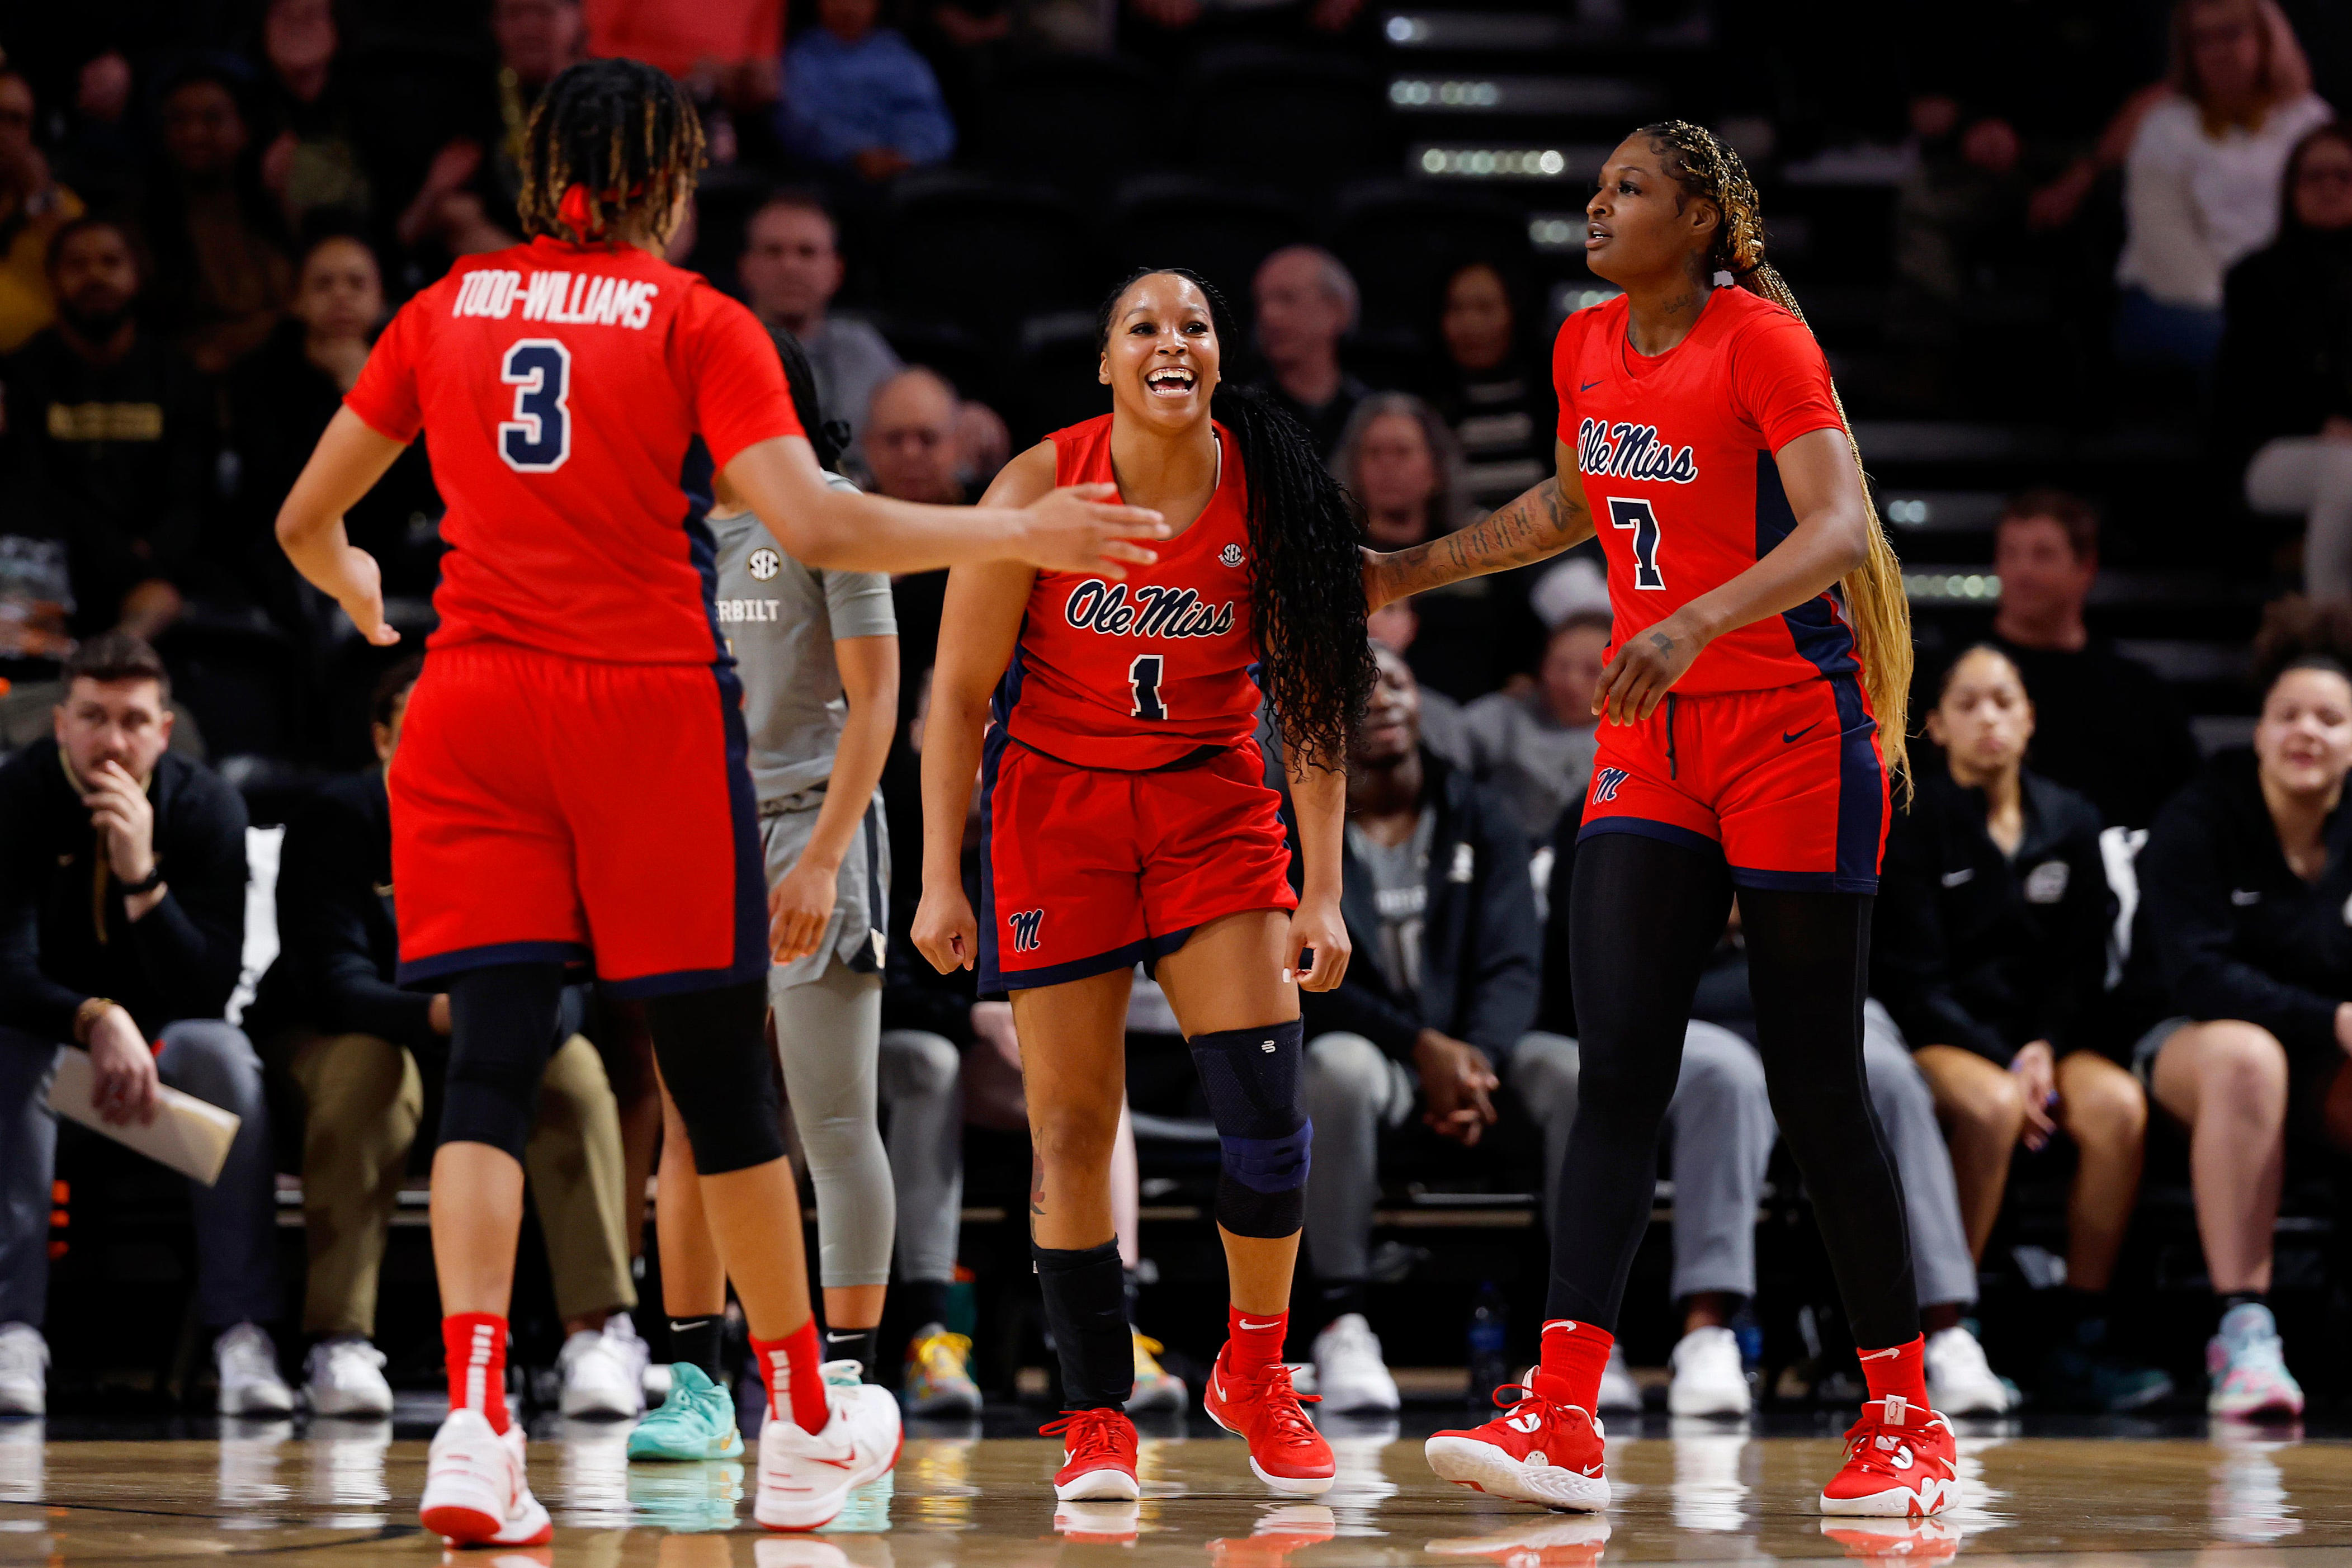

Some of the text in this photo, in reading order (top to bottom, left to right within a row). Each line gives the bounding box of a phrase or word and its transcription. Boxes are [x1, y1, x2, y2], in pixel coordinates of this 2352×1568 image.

[452, 269, 658, 330] TODD-WILLIAMS
[498, 338, 571, 473] 3
[1578, 417, 1699, 484] Ole Miss
[1224, 544, 1241, 562] SEC
[1606, 496, 1666, 591] 7
[715, 599, 780, 622] RBILT
[1065, 579, 1236, 639] Ole Miss
[1128, 654, 1168, 720] 1
[1593, 767, 1630, 805] M
[1008, 908, 1045, 952] M
